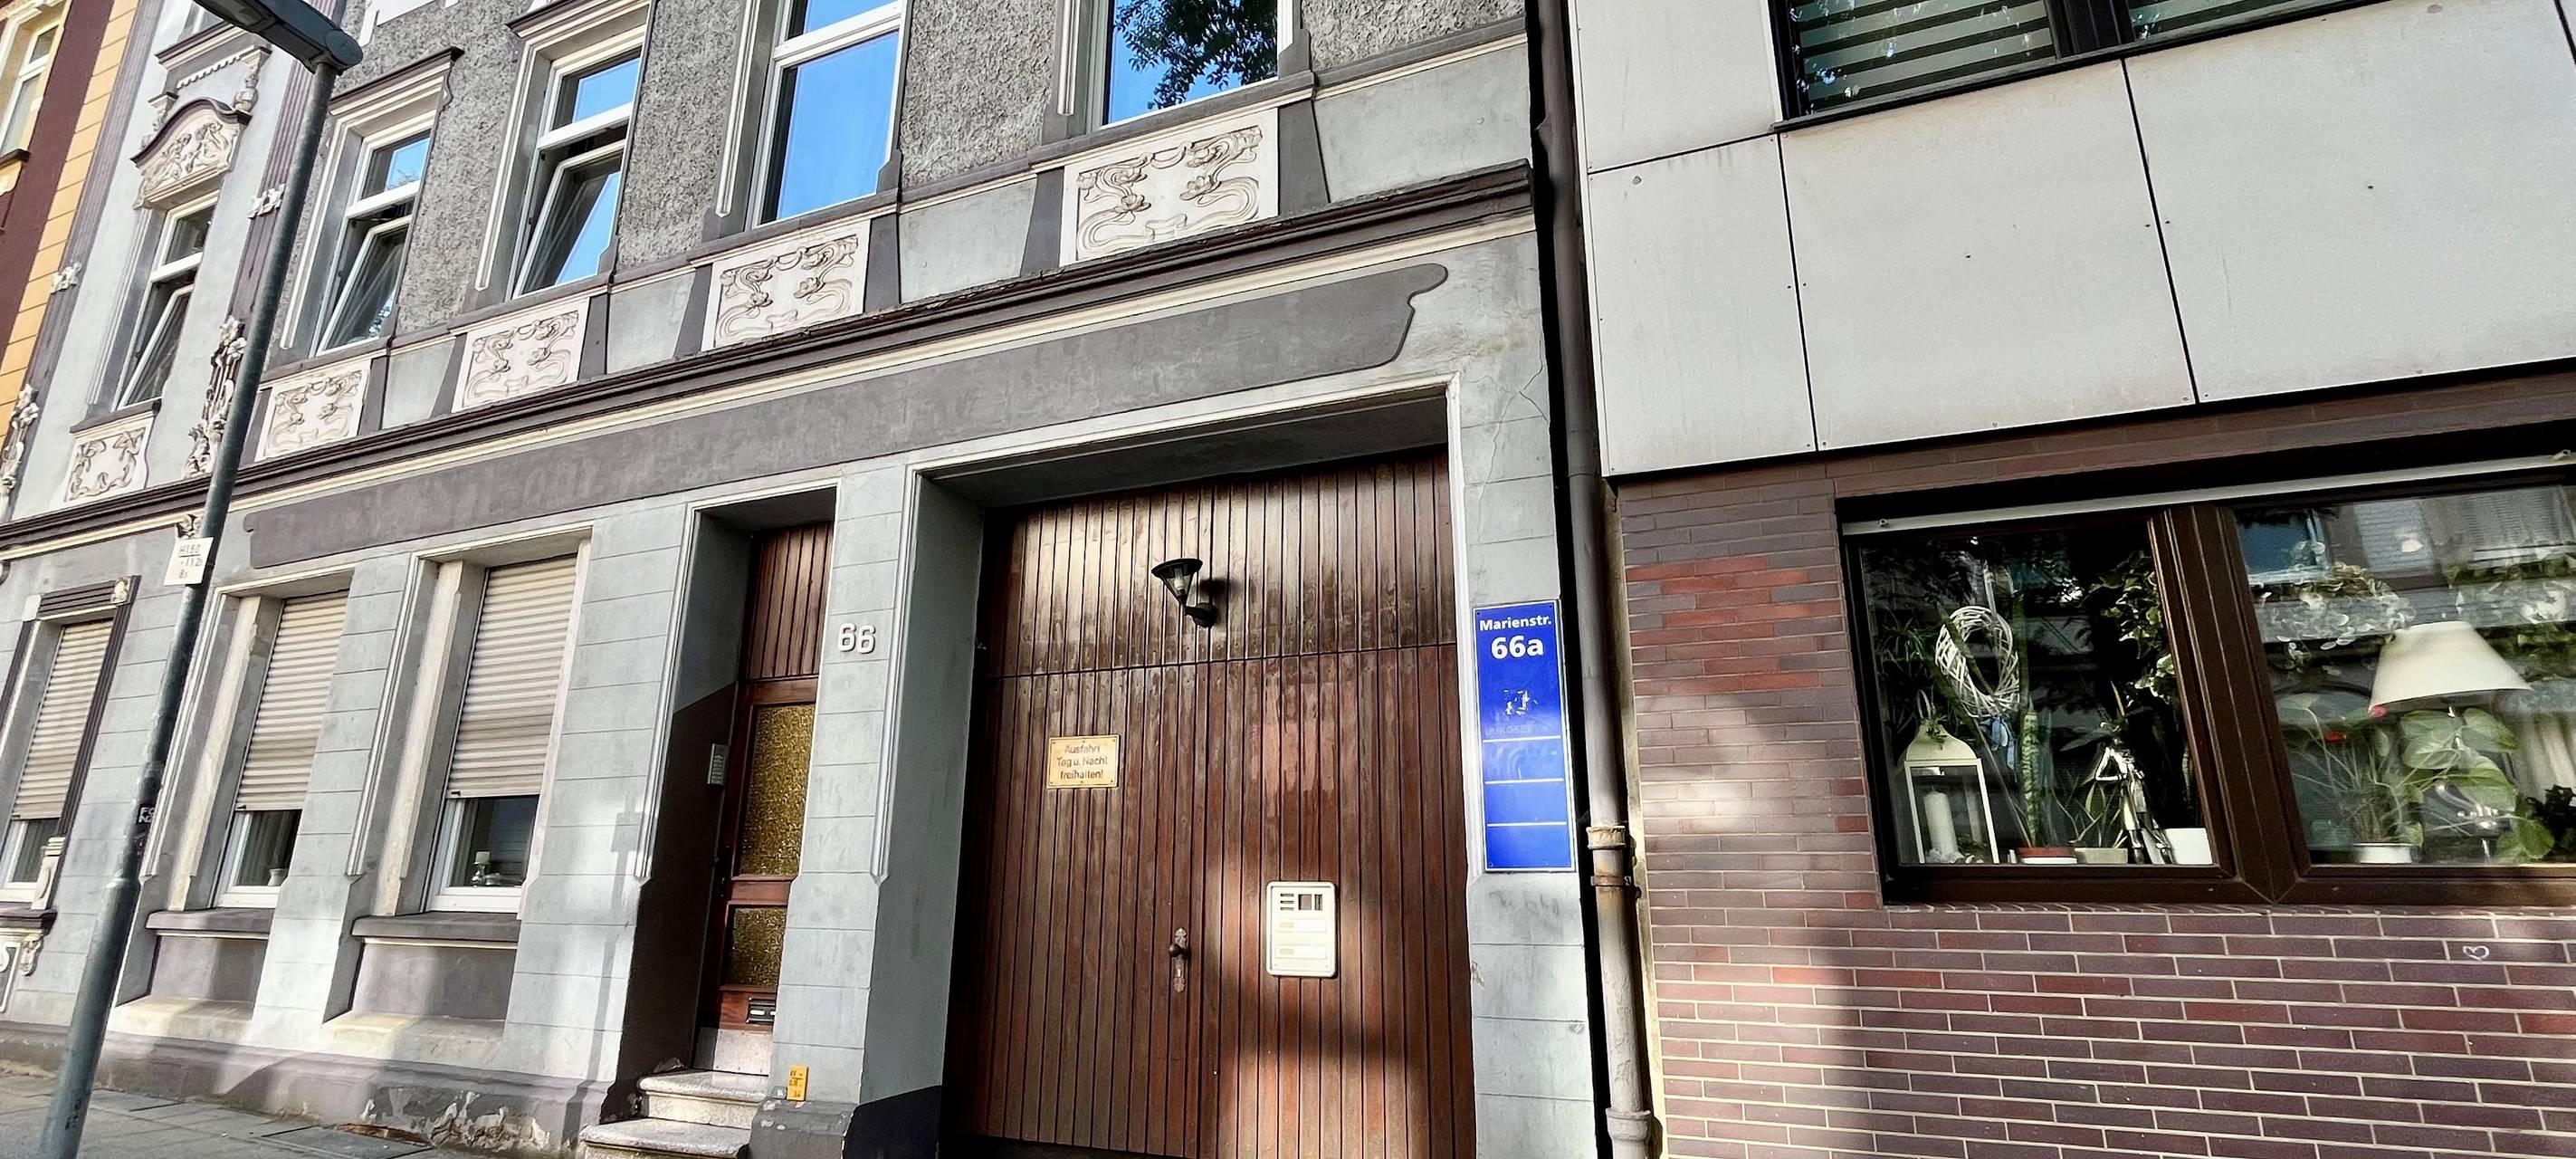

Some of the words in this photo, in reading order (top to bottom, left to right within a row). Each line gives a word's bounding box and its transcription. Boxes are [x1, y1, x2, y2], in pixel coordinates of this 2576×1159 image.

[1479, 615, 1552, 632] Marienstr.
[838, 622, 876, 655] 66
[1491, 635, 1544, 660] 66a
[1064, 744, 1101, 754] Ausfahrt
[1057, 757, 1072, 768] Tag
[1083, 756, 1108, 766] Nacht
[1060, 770, 1103, 780] freihalten!
